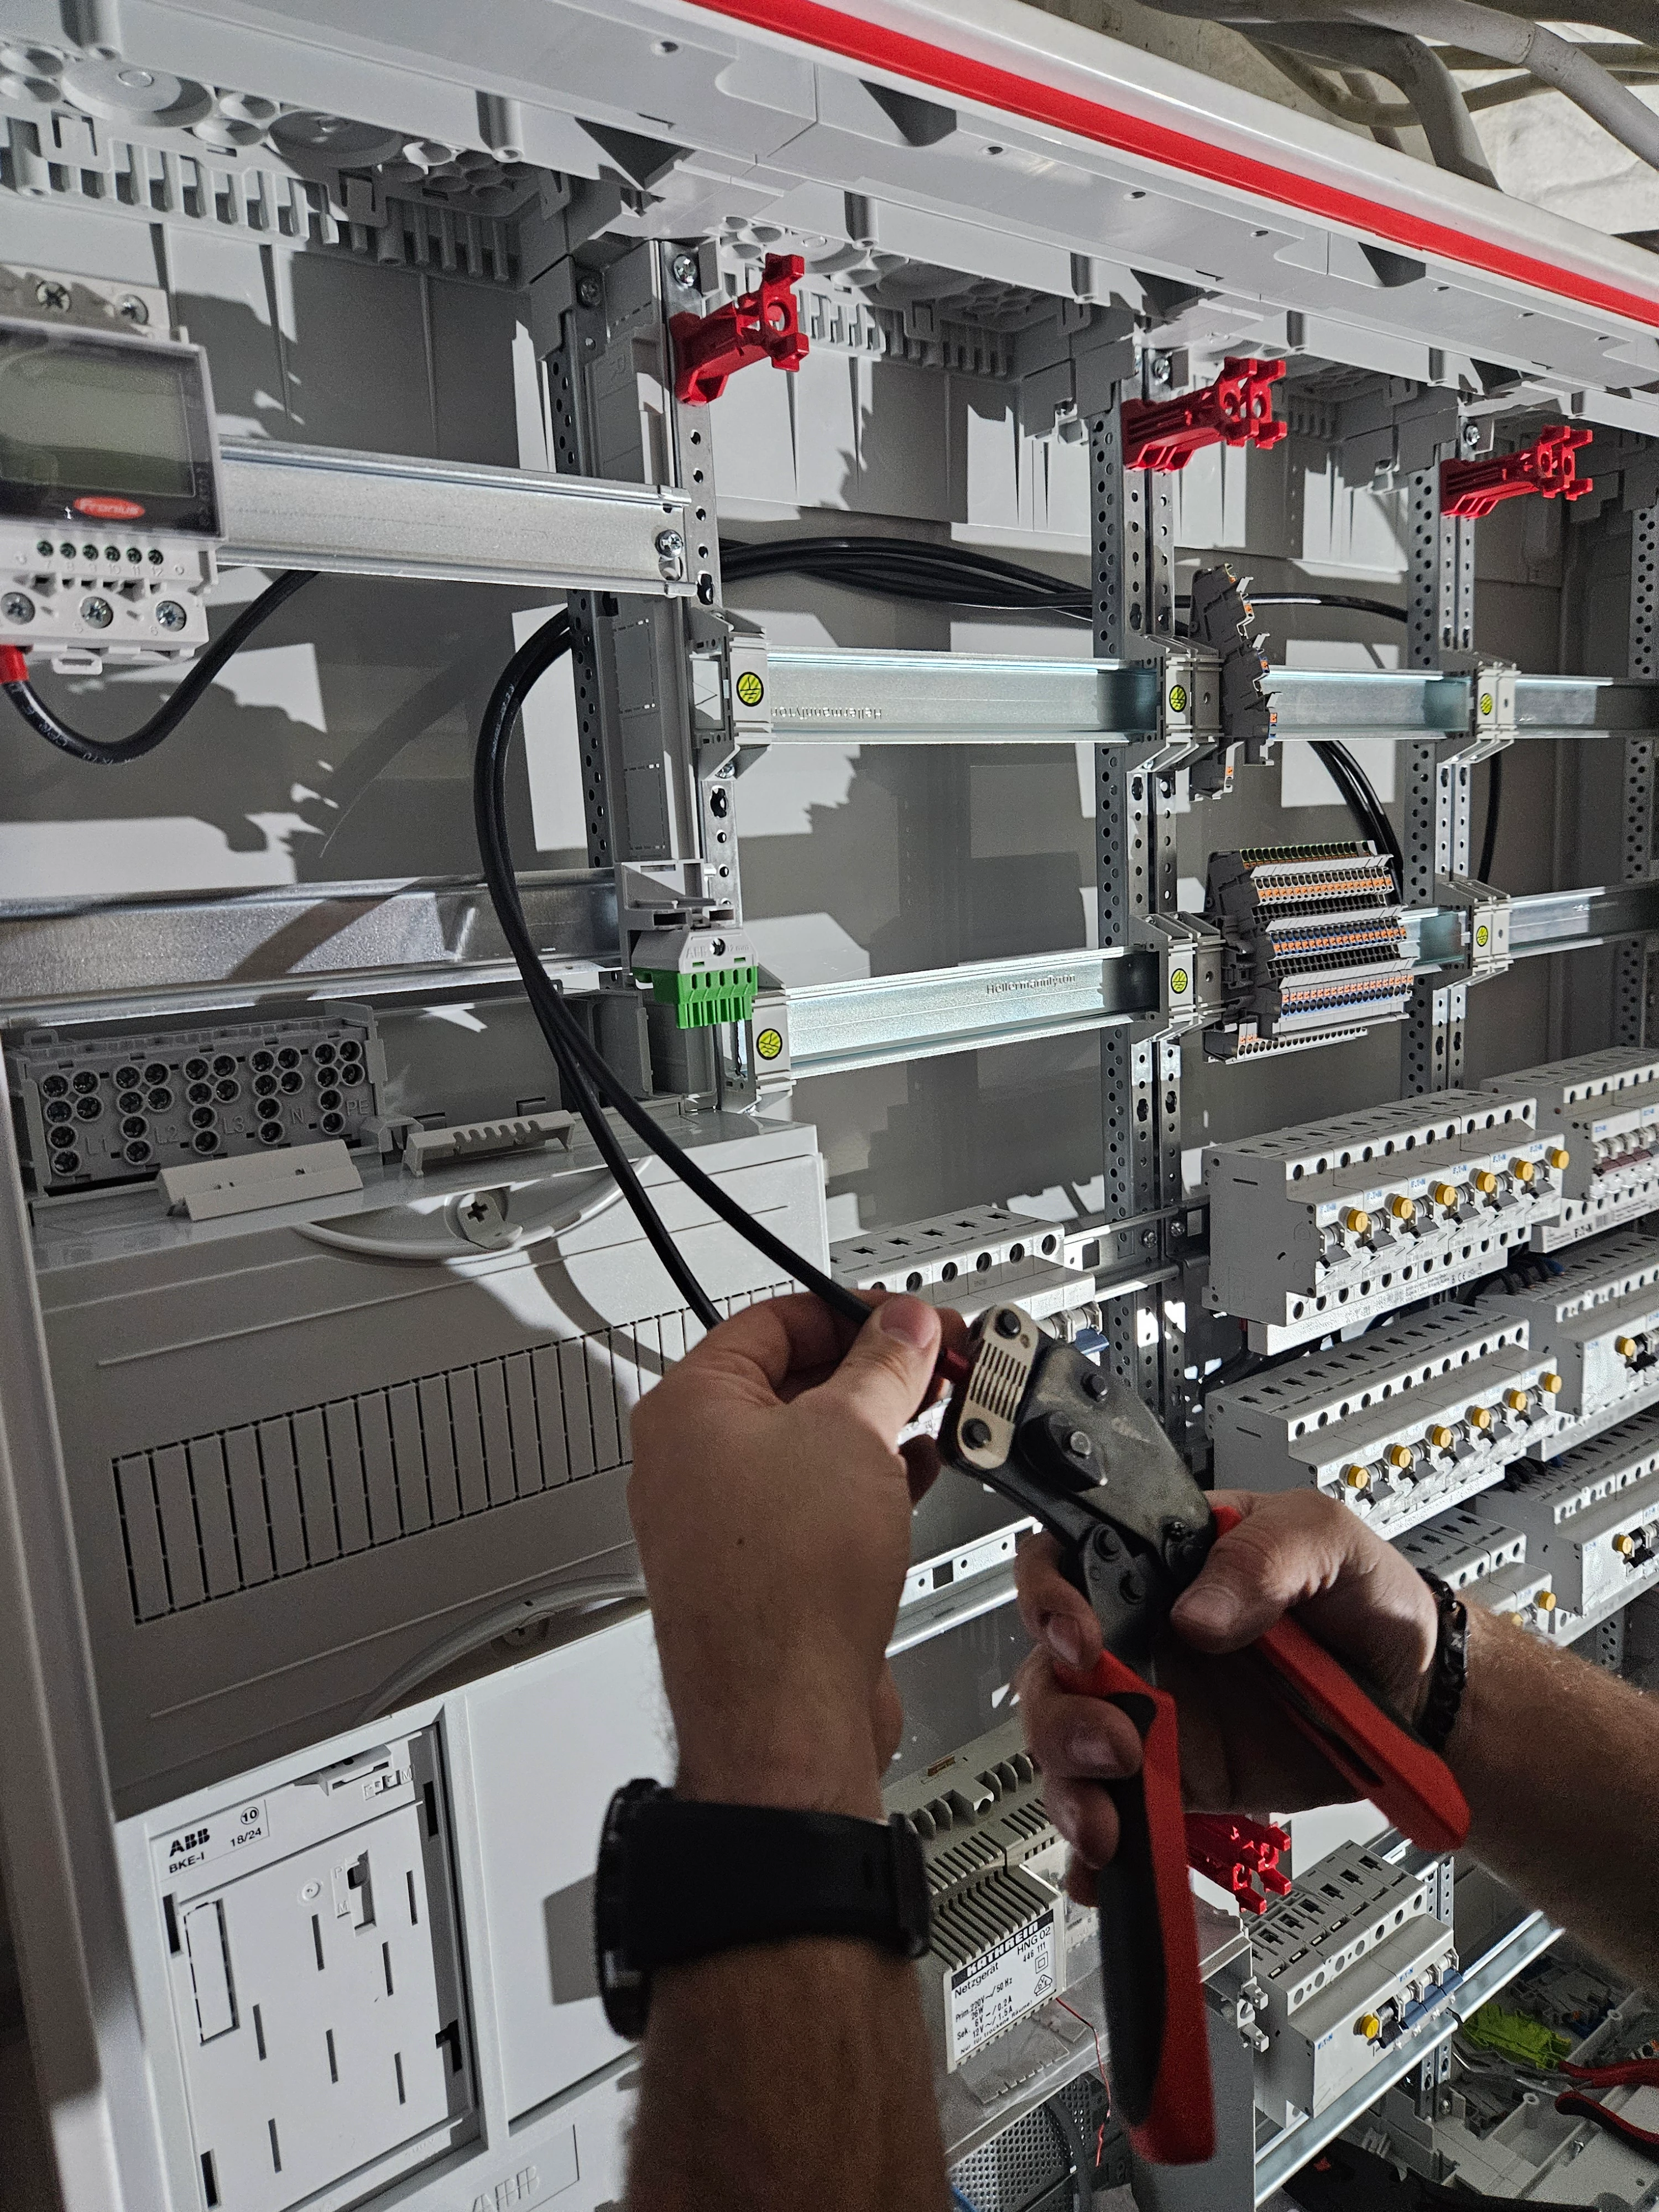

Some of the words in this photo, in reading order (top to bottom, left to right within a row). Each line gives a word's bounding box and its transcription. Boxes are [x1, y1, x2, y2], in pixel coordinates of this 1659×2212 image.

[223, 1116, 245, 1135] L3
[290, 1107, 305, 1124] N
[346, 1099, 371, 1116] PE
[242, 1809, 258, 1822] 10
[169, 1828, 210, 1858] ABB
[230, 1827, 262, 1847] 18/24
[169, 1851, 205, 1874] BKE-I
[1018, 1934, 1038, 1955] HNG
[1040, 1926, 1051, 1939] 02
[1023, 1949, 1034, 1962] 446
[1037, 1942, 1046, 1953] 111
[954, 1962, 999, 1999] Netzgerät
